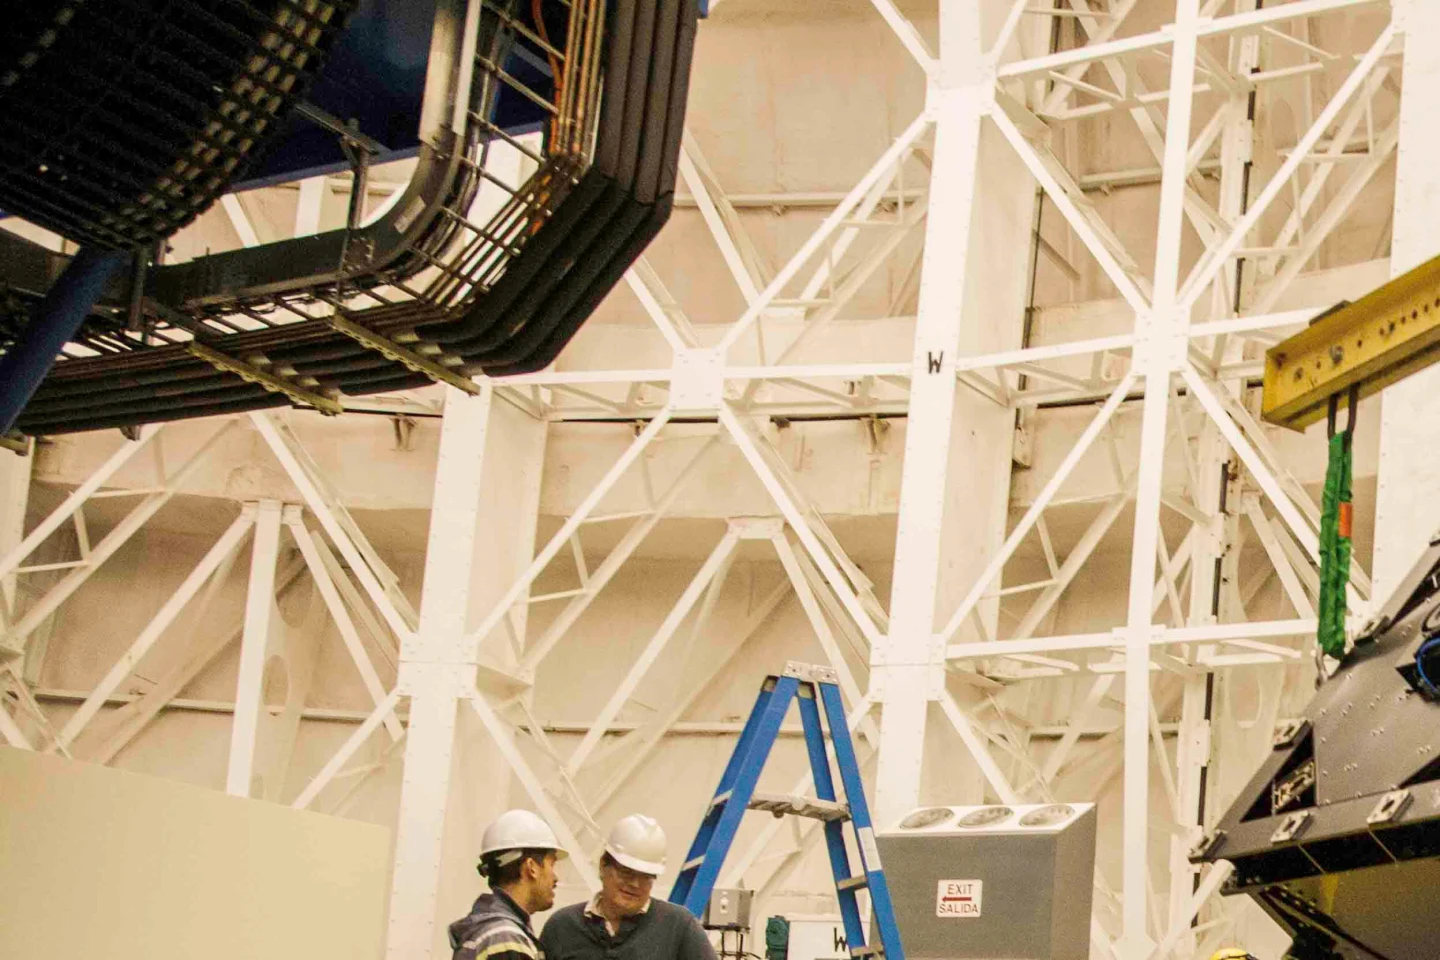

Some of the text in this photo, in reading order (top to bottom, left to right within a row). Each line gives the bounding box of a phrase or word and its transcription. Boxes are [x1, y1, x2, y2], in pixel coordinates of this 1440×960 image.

[928, 350, 944, 374] W
[947, 883, 973, 895] EXIT
[939, 903, 979, 914] SALIDA
